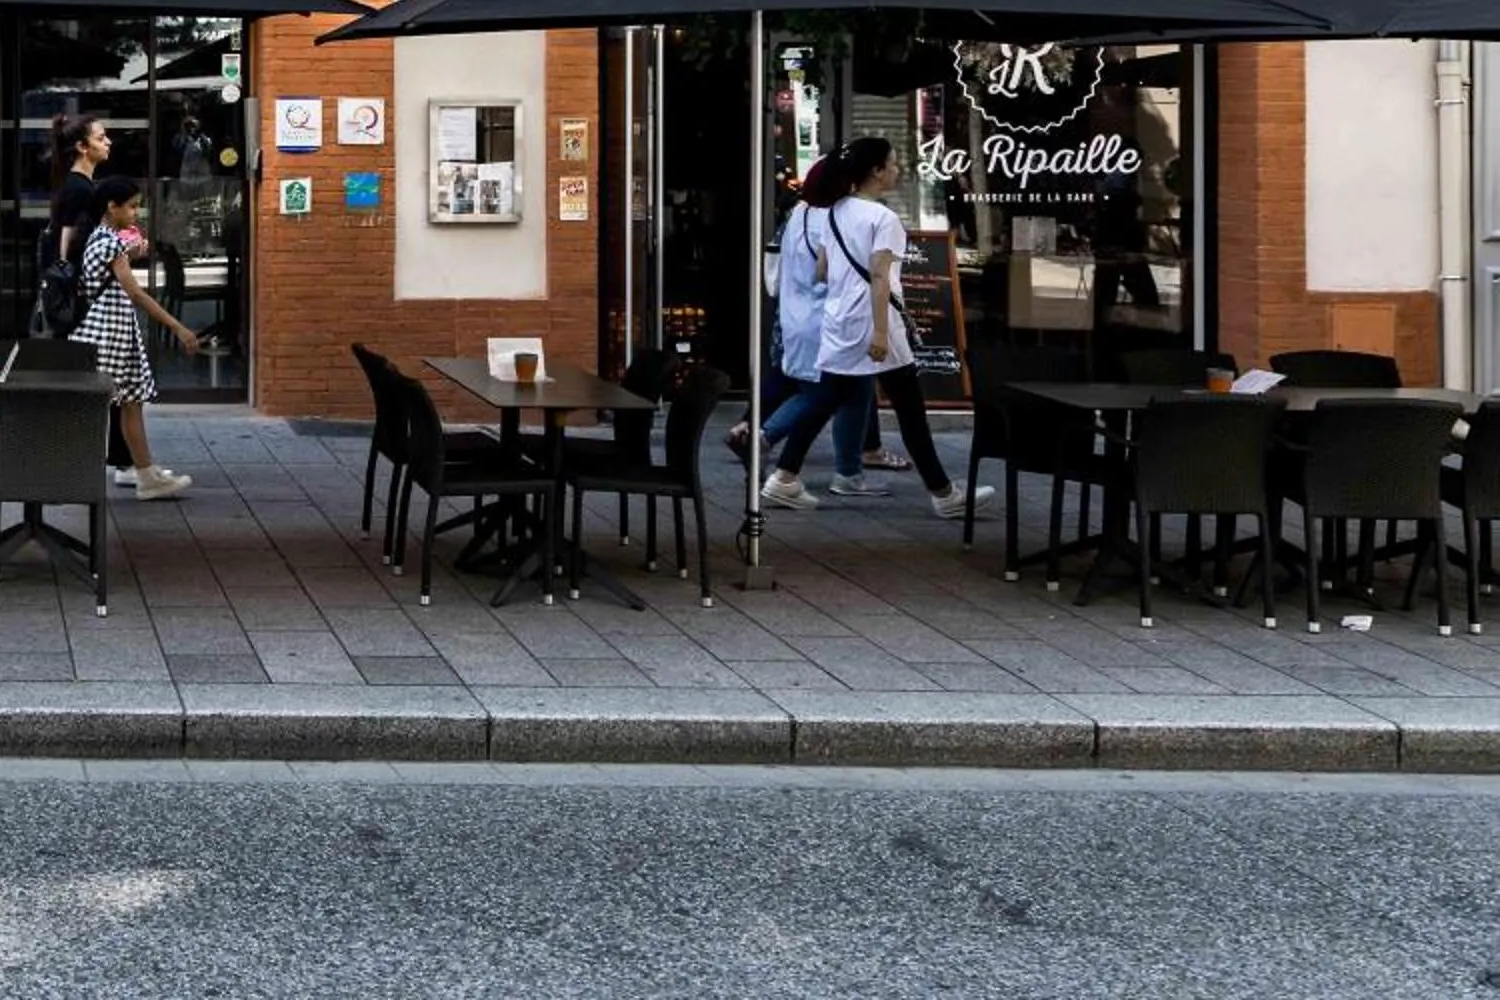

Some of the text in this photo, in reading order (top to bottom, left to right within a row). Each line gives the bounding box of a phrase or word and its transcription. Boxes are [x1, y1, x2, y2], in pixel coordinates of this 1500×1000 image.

[917, 133, 1142, 189] La Ripaille
[1047, 193, 1061, 203] LA
